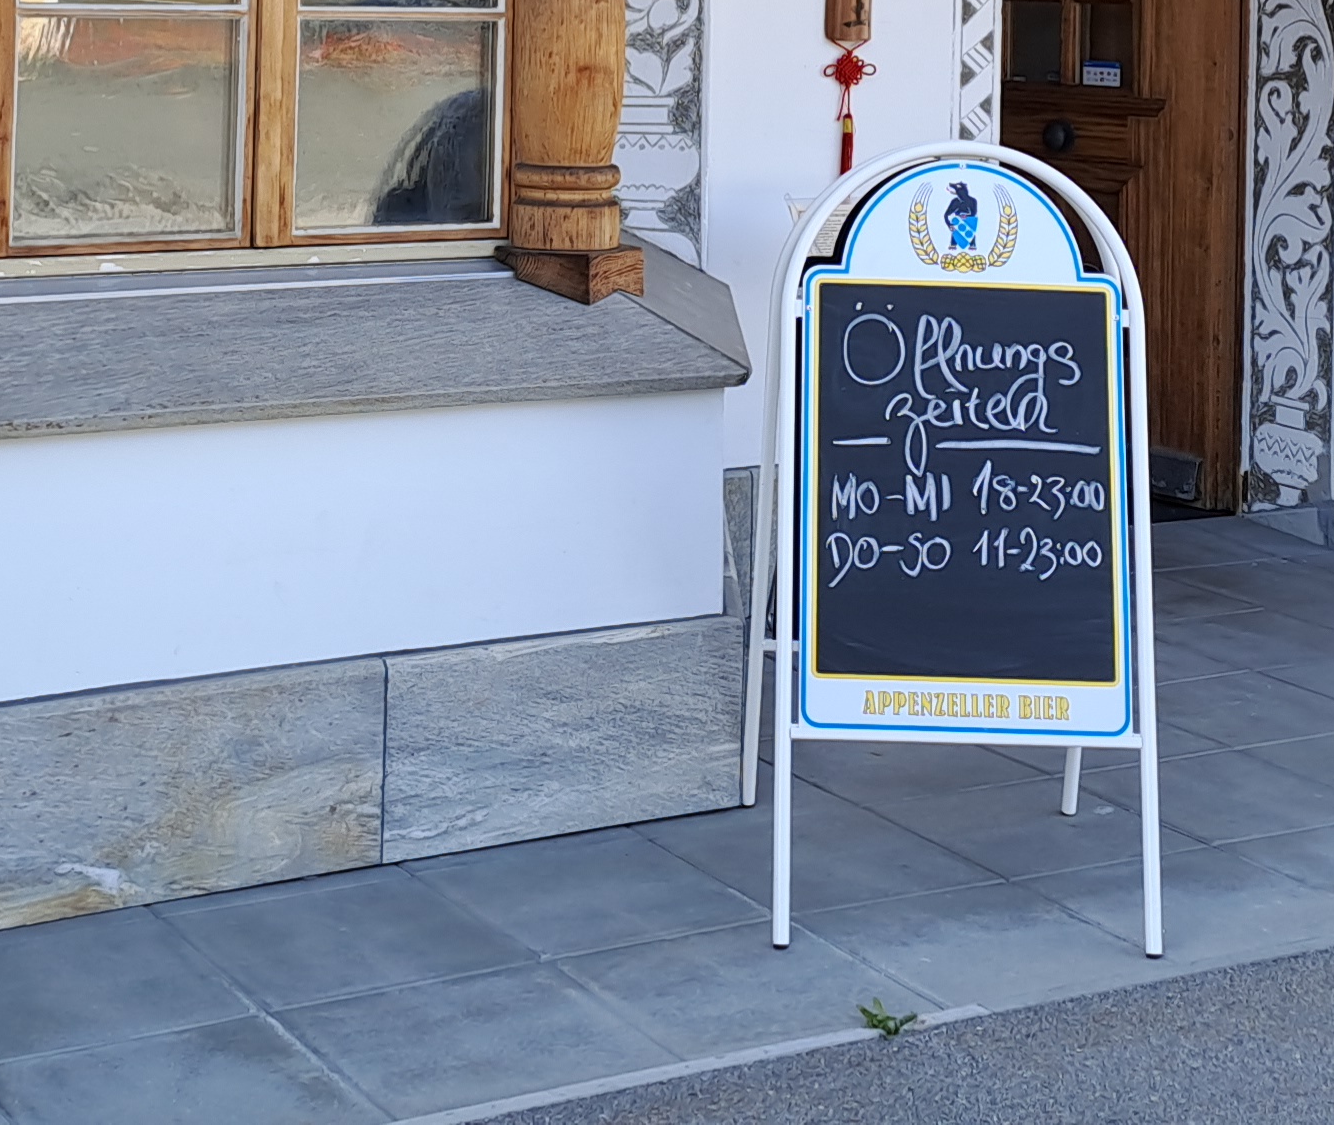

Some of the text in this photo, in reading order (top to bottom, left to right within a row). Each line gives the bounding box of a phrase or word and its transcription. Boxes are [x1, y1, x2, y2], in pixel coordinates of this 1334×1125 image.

[842, 301, 1082, 403] Öffnungs
[972, 459, 1105, 520] 18-23:00
[972, 526, 1103, 581] 11-23:00
[862, 689, 1071, 721] APPENZELLER BIER
